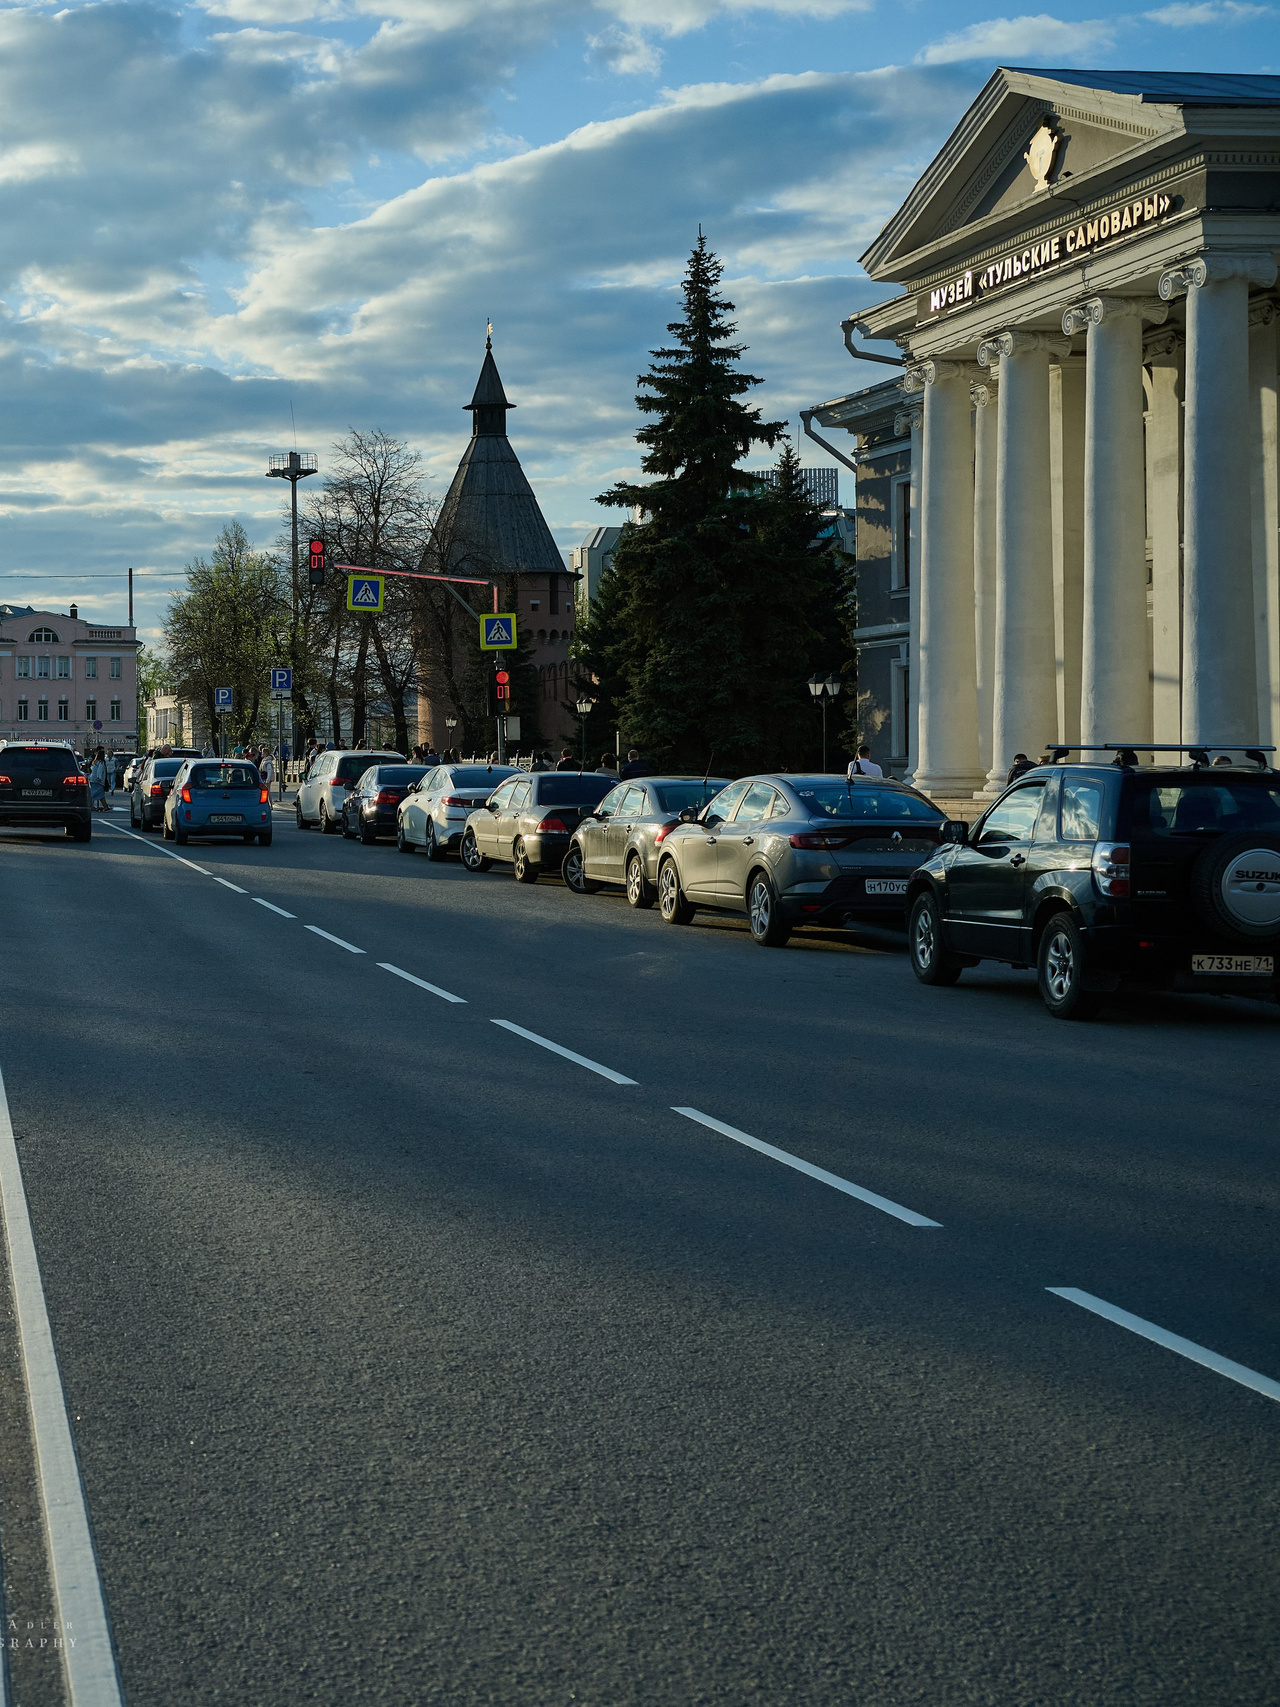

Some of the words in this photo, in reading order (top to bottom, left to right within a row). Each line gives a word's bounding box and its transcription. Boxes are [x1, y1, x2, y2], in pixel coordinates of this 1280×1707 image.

[930, 270, 973, 312] МУЗЕЙ
[978, 237, 1060, 290] «ТУЛЬСКИЕ
[1066, 194, 1170, 253] САМОВАРЫ»
[311, 555, 324, 569] 07
[497, 685, 510, 699] 07
